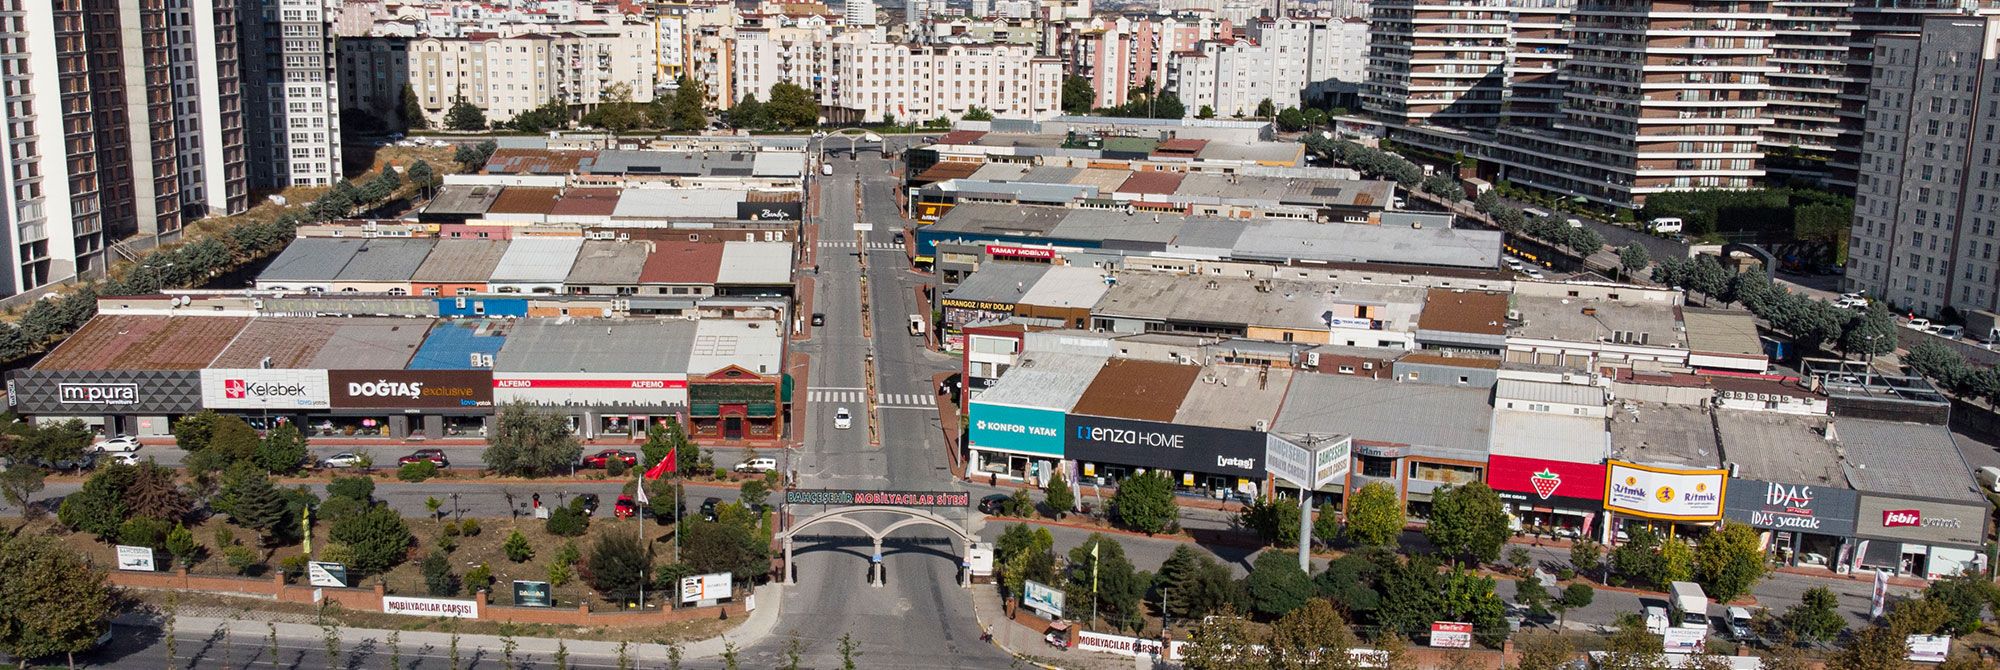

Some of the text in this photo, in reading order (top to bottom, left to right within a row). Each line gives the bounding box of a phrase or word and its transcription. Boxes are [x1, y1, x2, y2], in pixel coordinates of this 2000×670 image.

[942, 299, 976, 308] MARANGOZ
[993, 303, 1014, 311] DOLAP
[246, 382, 306, 396] Kelebek
[423, 386, 473, 396] exclusive
[987, 421, 1057, 437] KONFOR YATAK
[1091, 427, 1184, 449] enza HOME
[787, 490, 968, 505] BAHÇEŞEHİR MOBİLYACILAR SİTESİ
[1776, 516, 1820, 529] yatak
